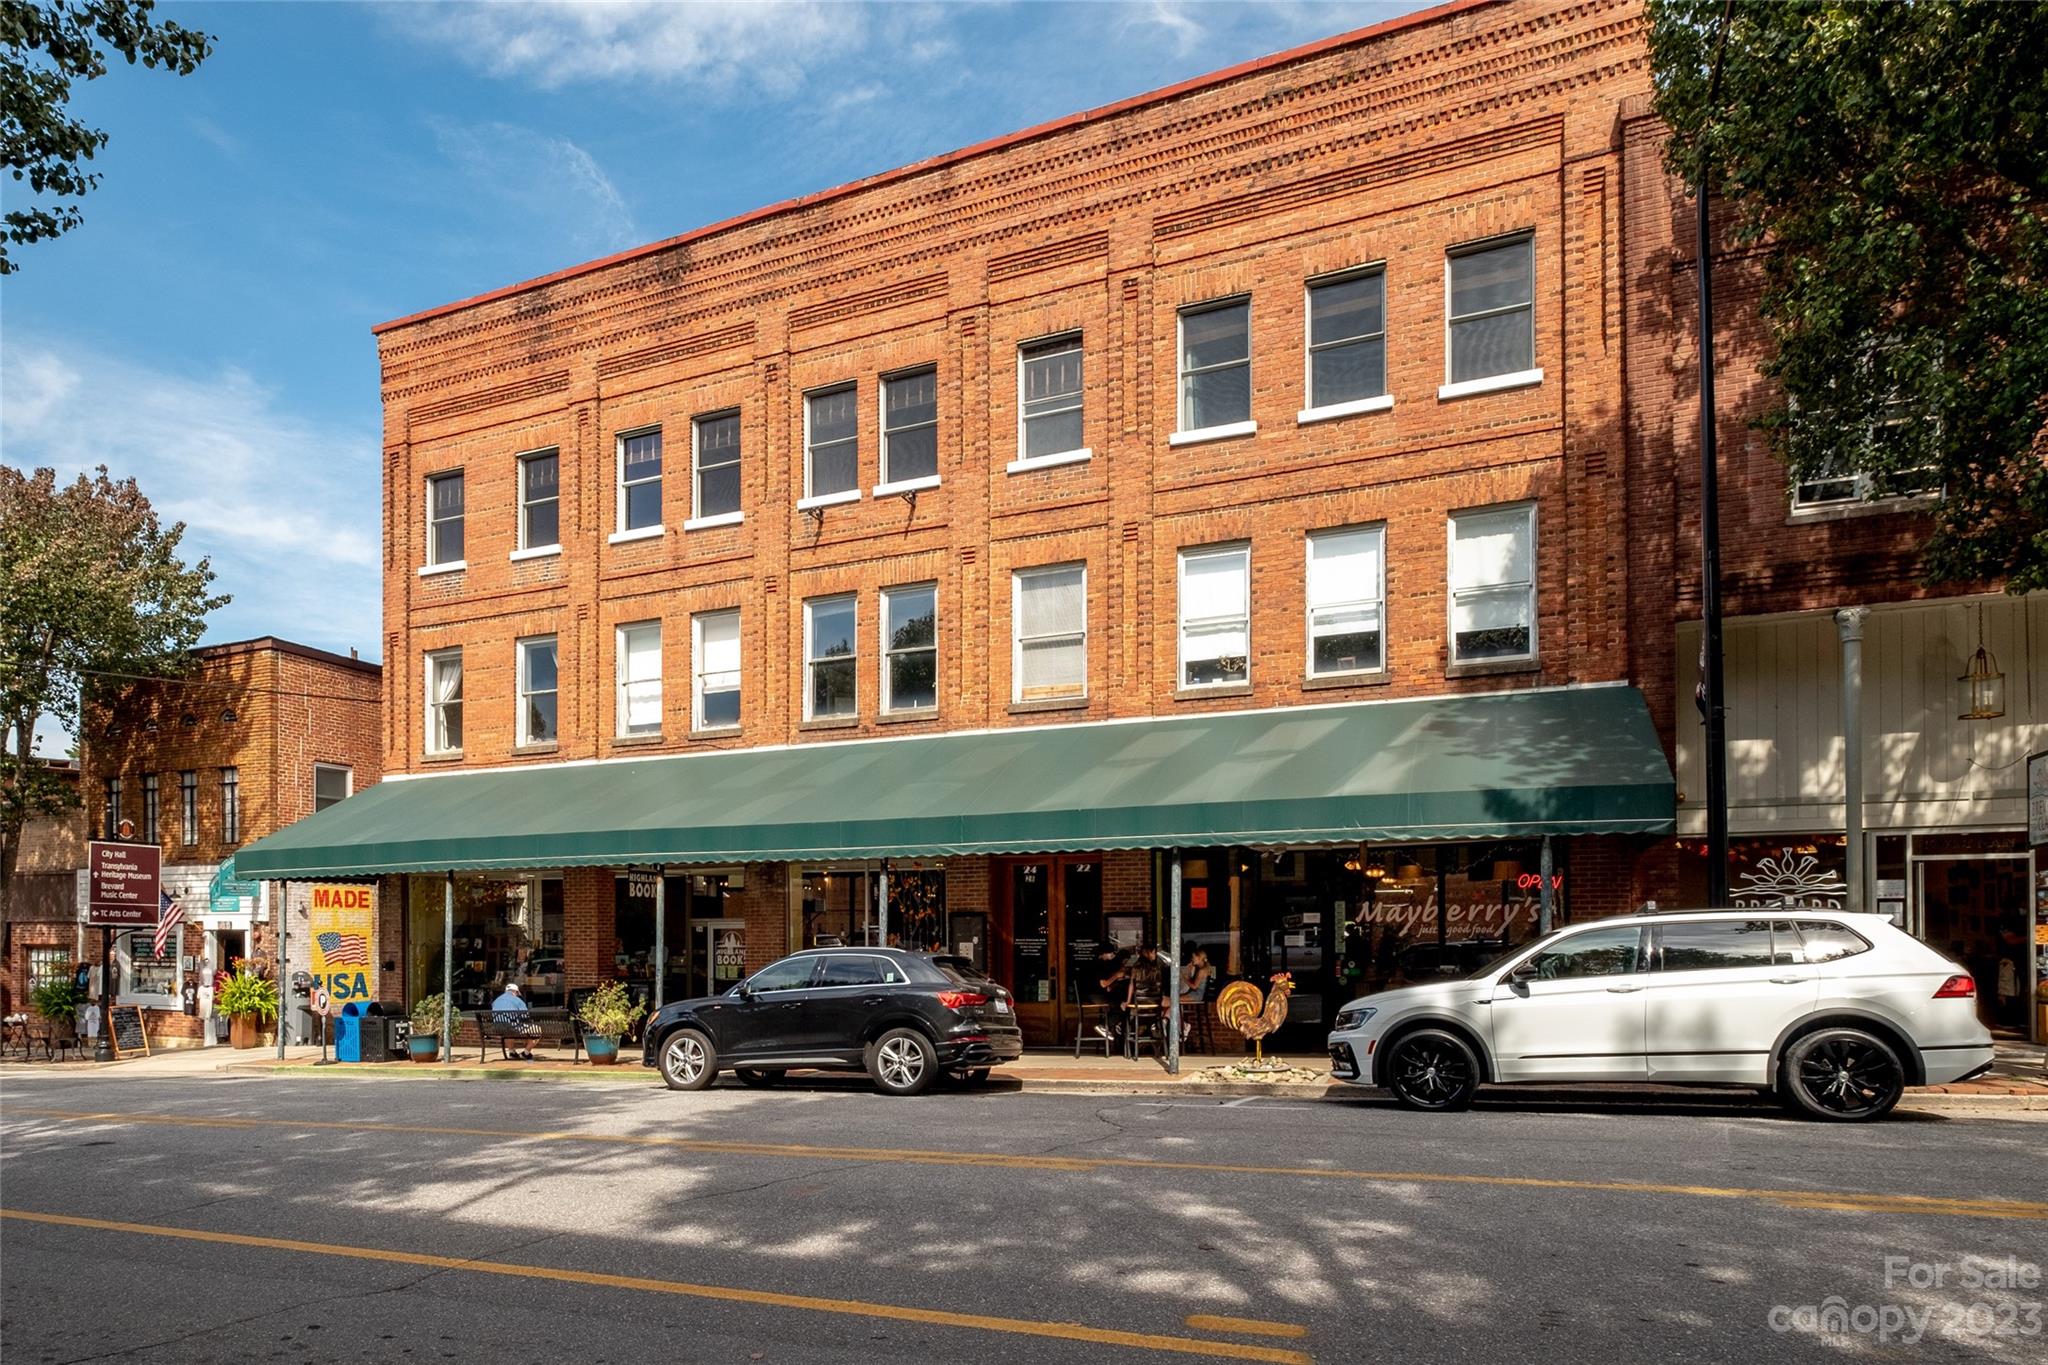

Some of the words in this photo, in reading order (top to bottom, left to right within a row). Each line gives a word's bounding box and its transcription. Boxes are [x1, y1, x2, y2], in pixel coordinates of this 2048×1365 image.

[101, 850, 114, 859] City
[114, 851, 127, 859] Hall
[101, 862, 138, 871] Transylvania
[1023, 866, 1038, 874] 24
[1076, 864, 1092, 873] 22
[101, 871, 127, 880] Heritage
[127, 872, 152, 880] Museum
[629, 873, 657, 883] HIGHLAN
[101, 882, 124, 890] Brevard
[629, 882, 657, 898] BOOK
[100, 891, 117, 899] Music
[118, 892, 138, 900] Center
[314, 889, 370, 909] MADE
[100, 909, 109, 917] TC
[122, 910, 142, 918] Center
[1355, 894, 1541, 937] Mayberry's
[1445, 923, 1471, 938] good
[1469, 923, 1495, 938] food
